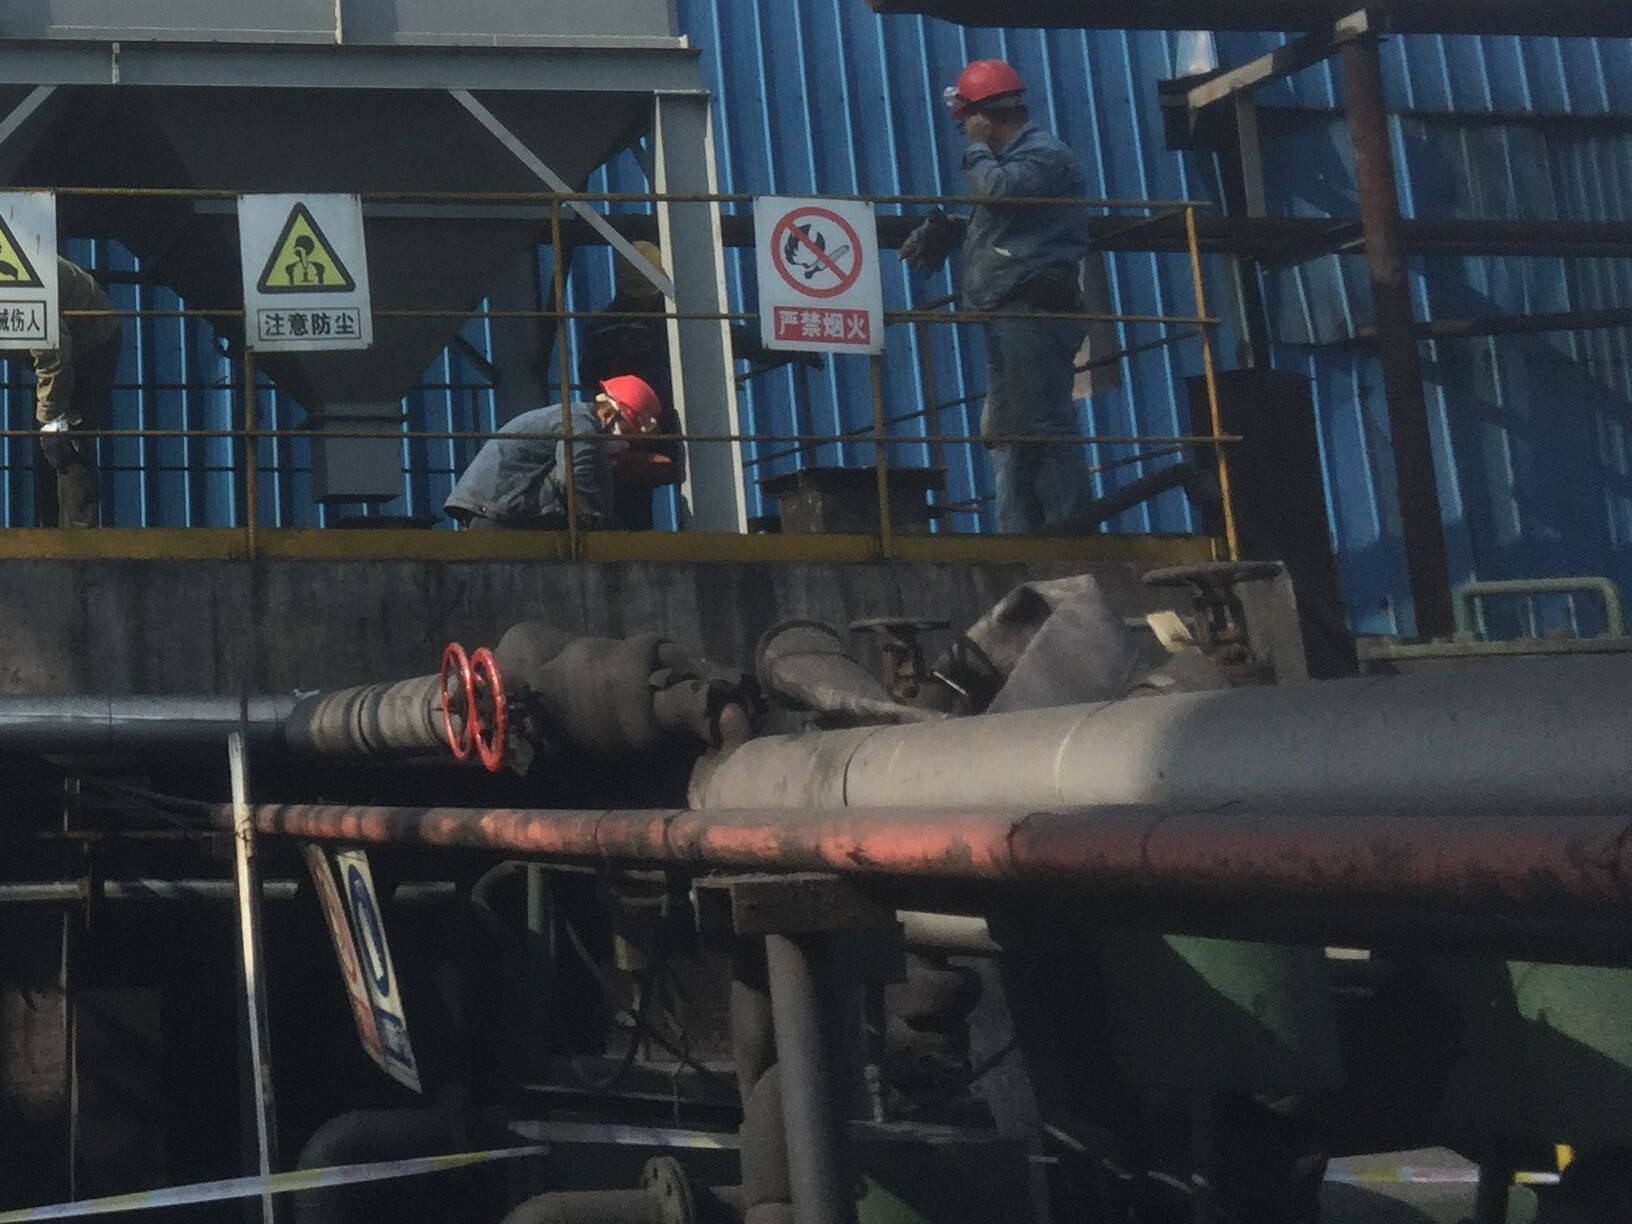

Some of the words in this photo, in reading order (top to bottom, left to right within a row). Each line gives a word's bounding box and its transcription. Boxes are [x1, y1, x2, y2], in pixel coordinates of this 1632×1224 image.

[264, 312, 355, 336] 注意防尘
[778, 310, 867, 339] 严禁烟火
